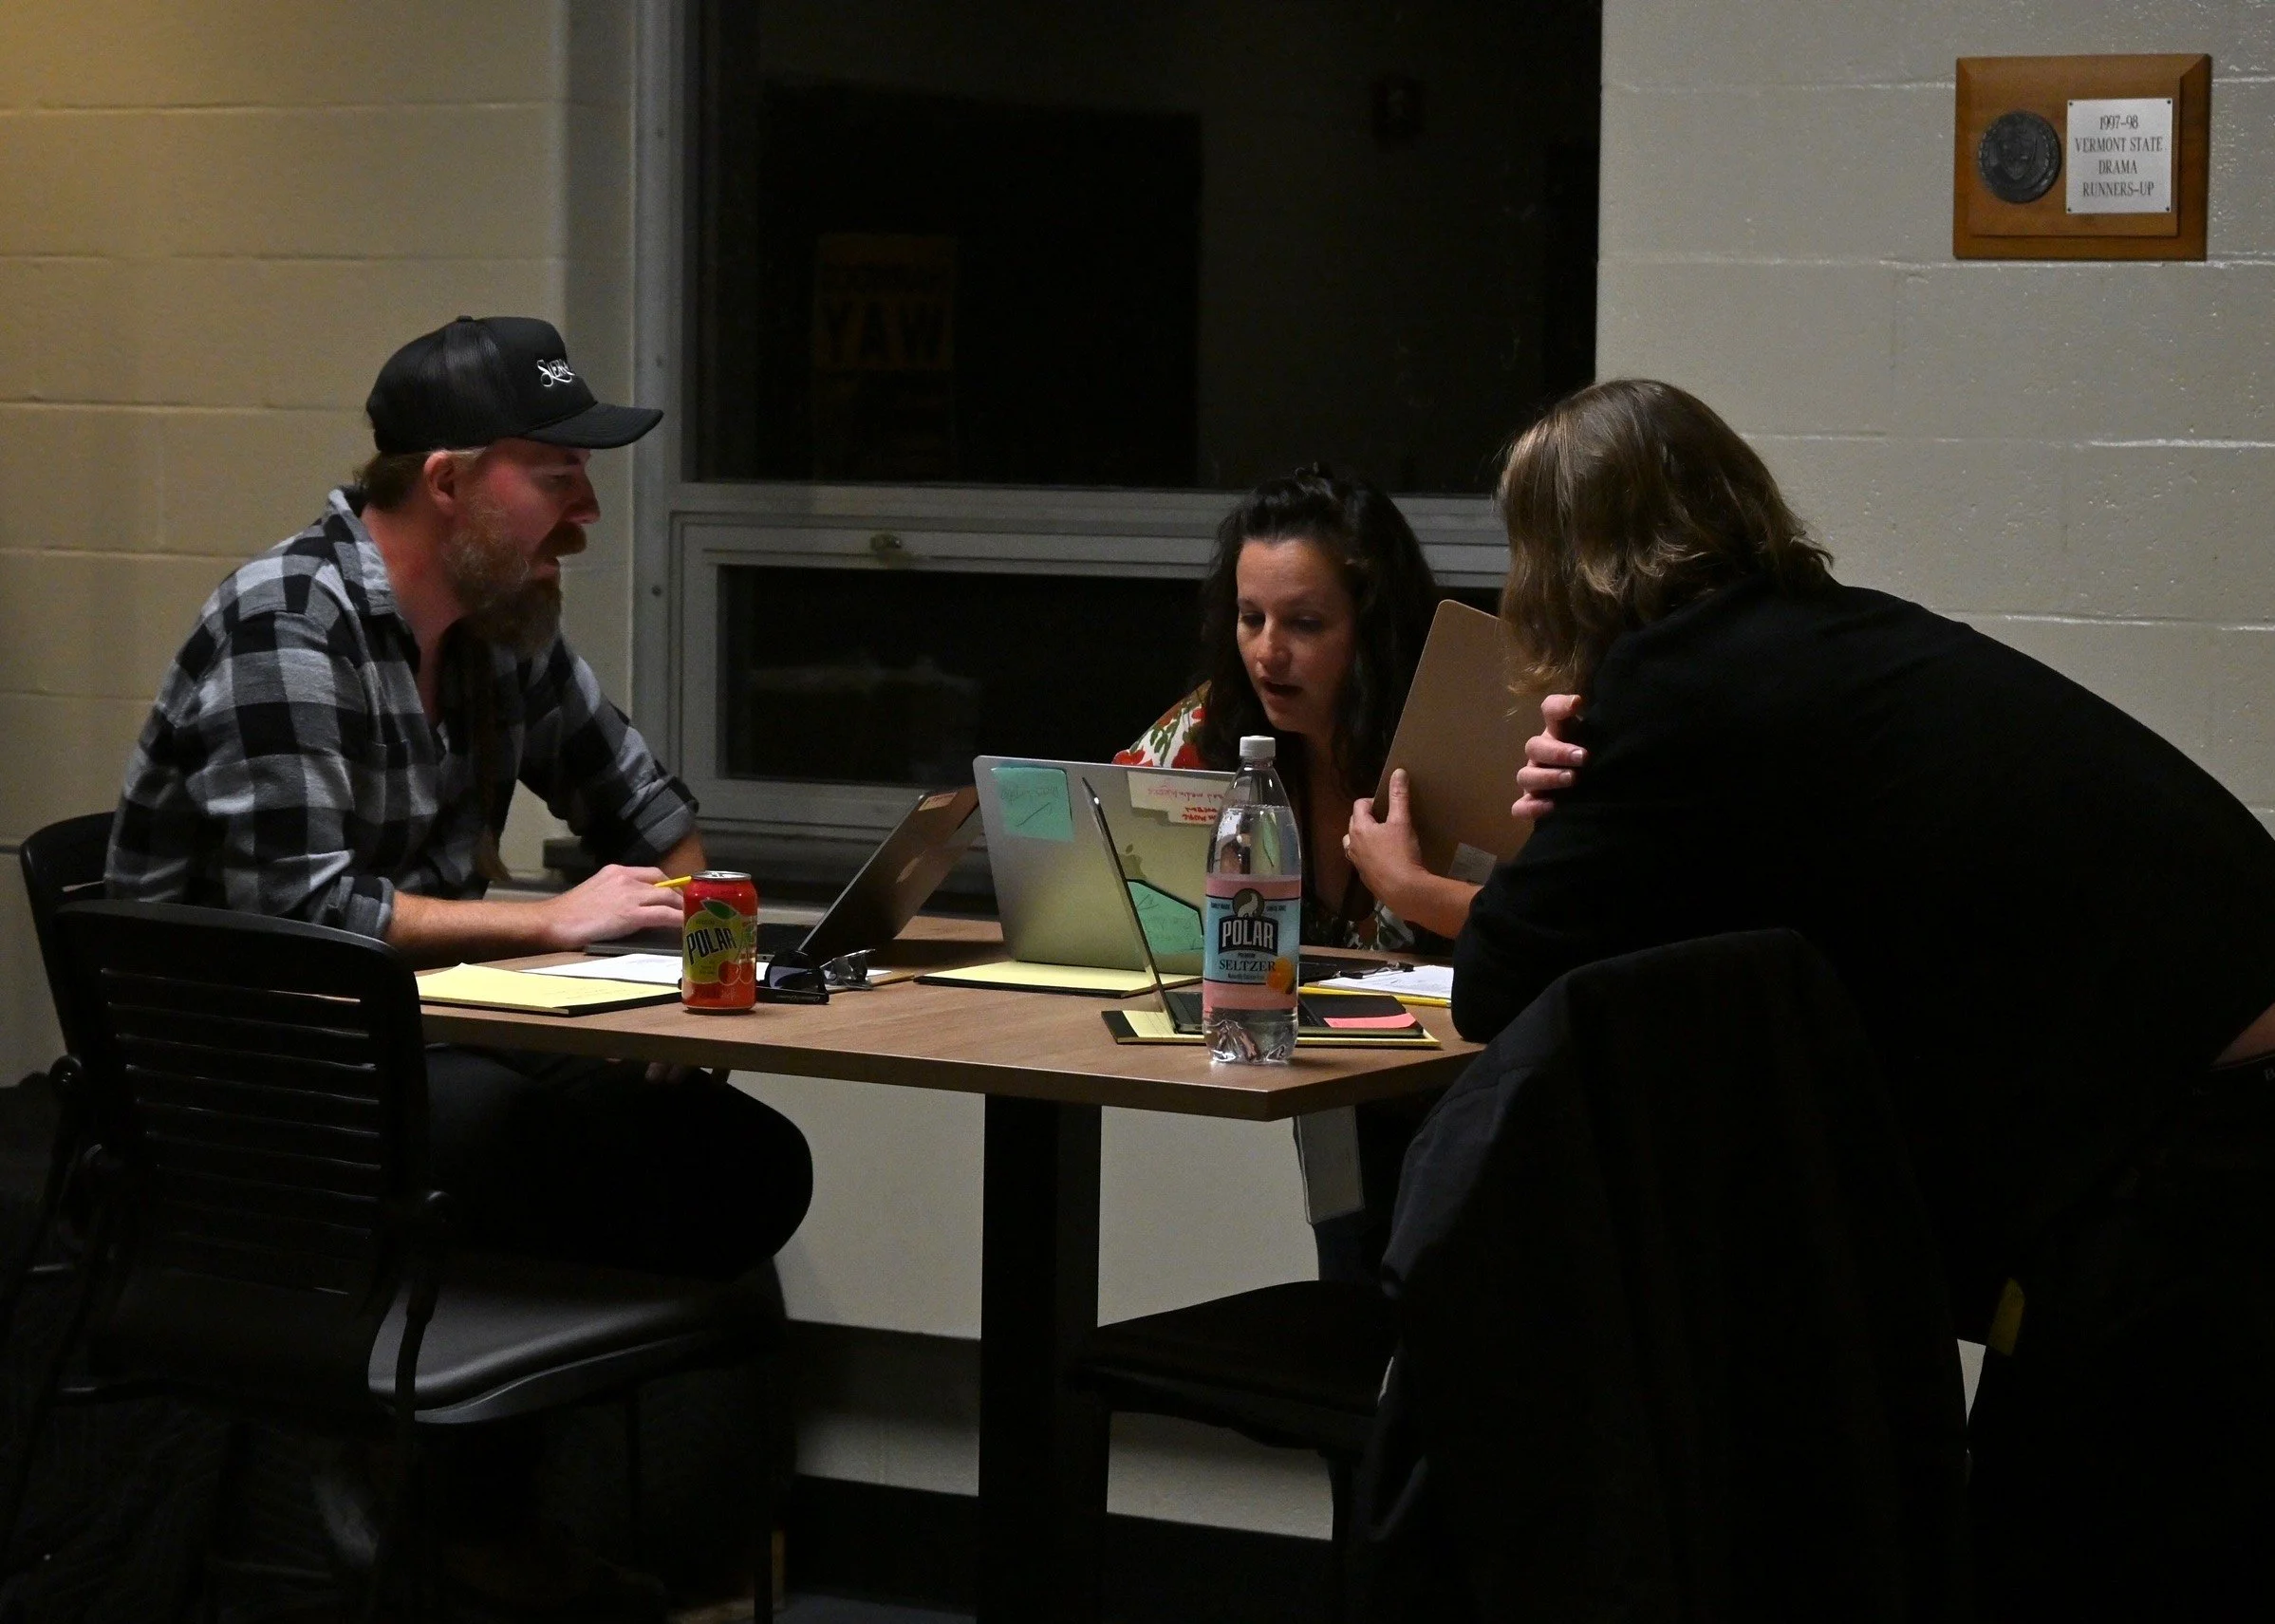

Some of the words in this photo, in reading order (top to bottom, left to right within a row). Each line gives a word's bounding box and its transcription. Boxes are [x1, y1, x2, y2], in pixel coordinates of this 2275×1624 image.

[2074, 137, 2126, 154] VERMONT
[2130, 136, 2163, 152] STATE
[2098, 159, 2138, 176] DRAMA
[2081, 180, 2155, 197] RUNNERS-UP
[1221, 919, 1275, 950] POLAR
[686, 927, 737, 965] POLAR
[1219, 959, 1277, 972] SELTZER
